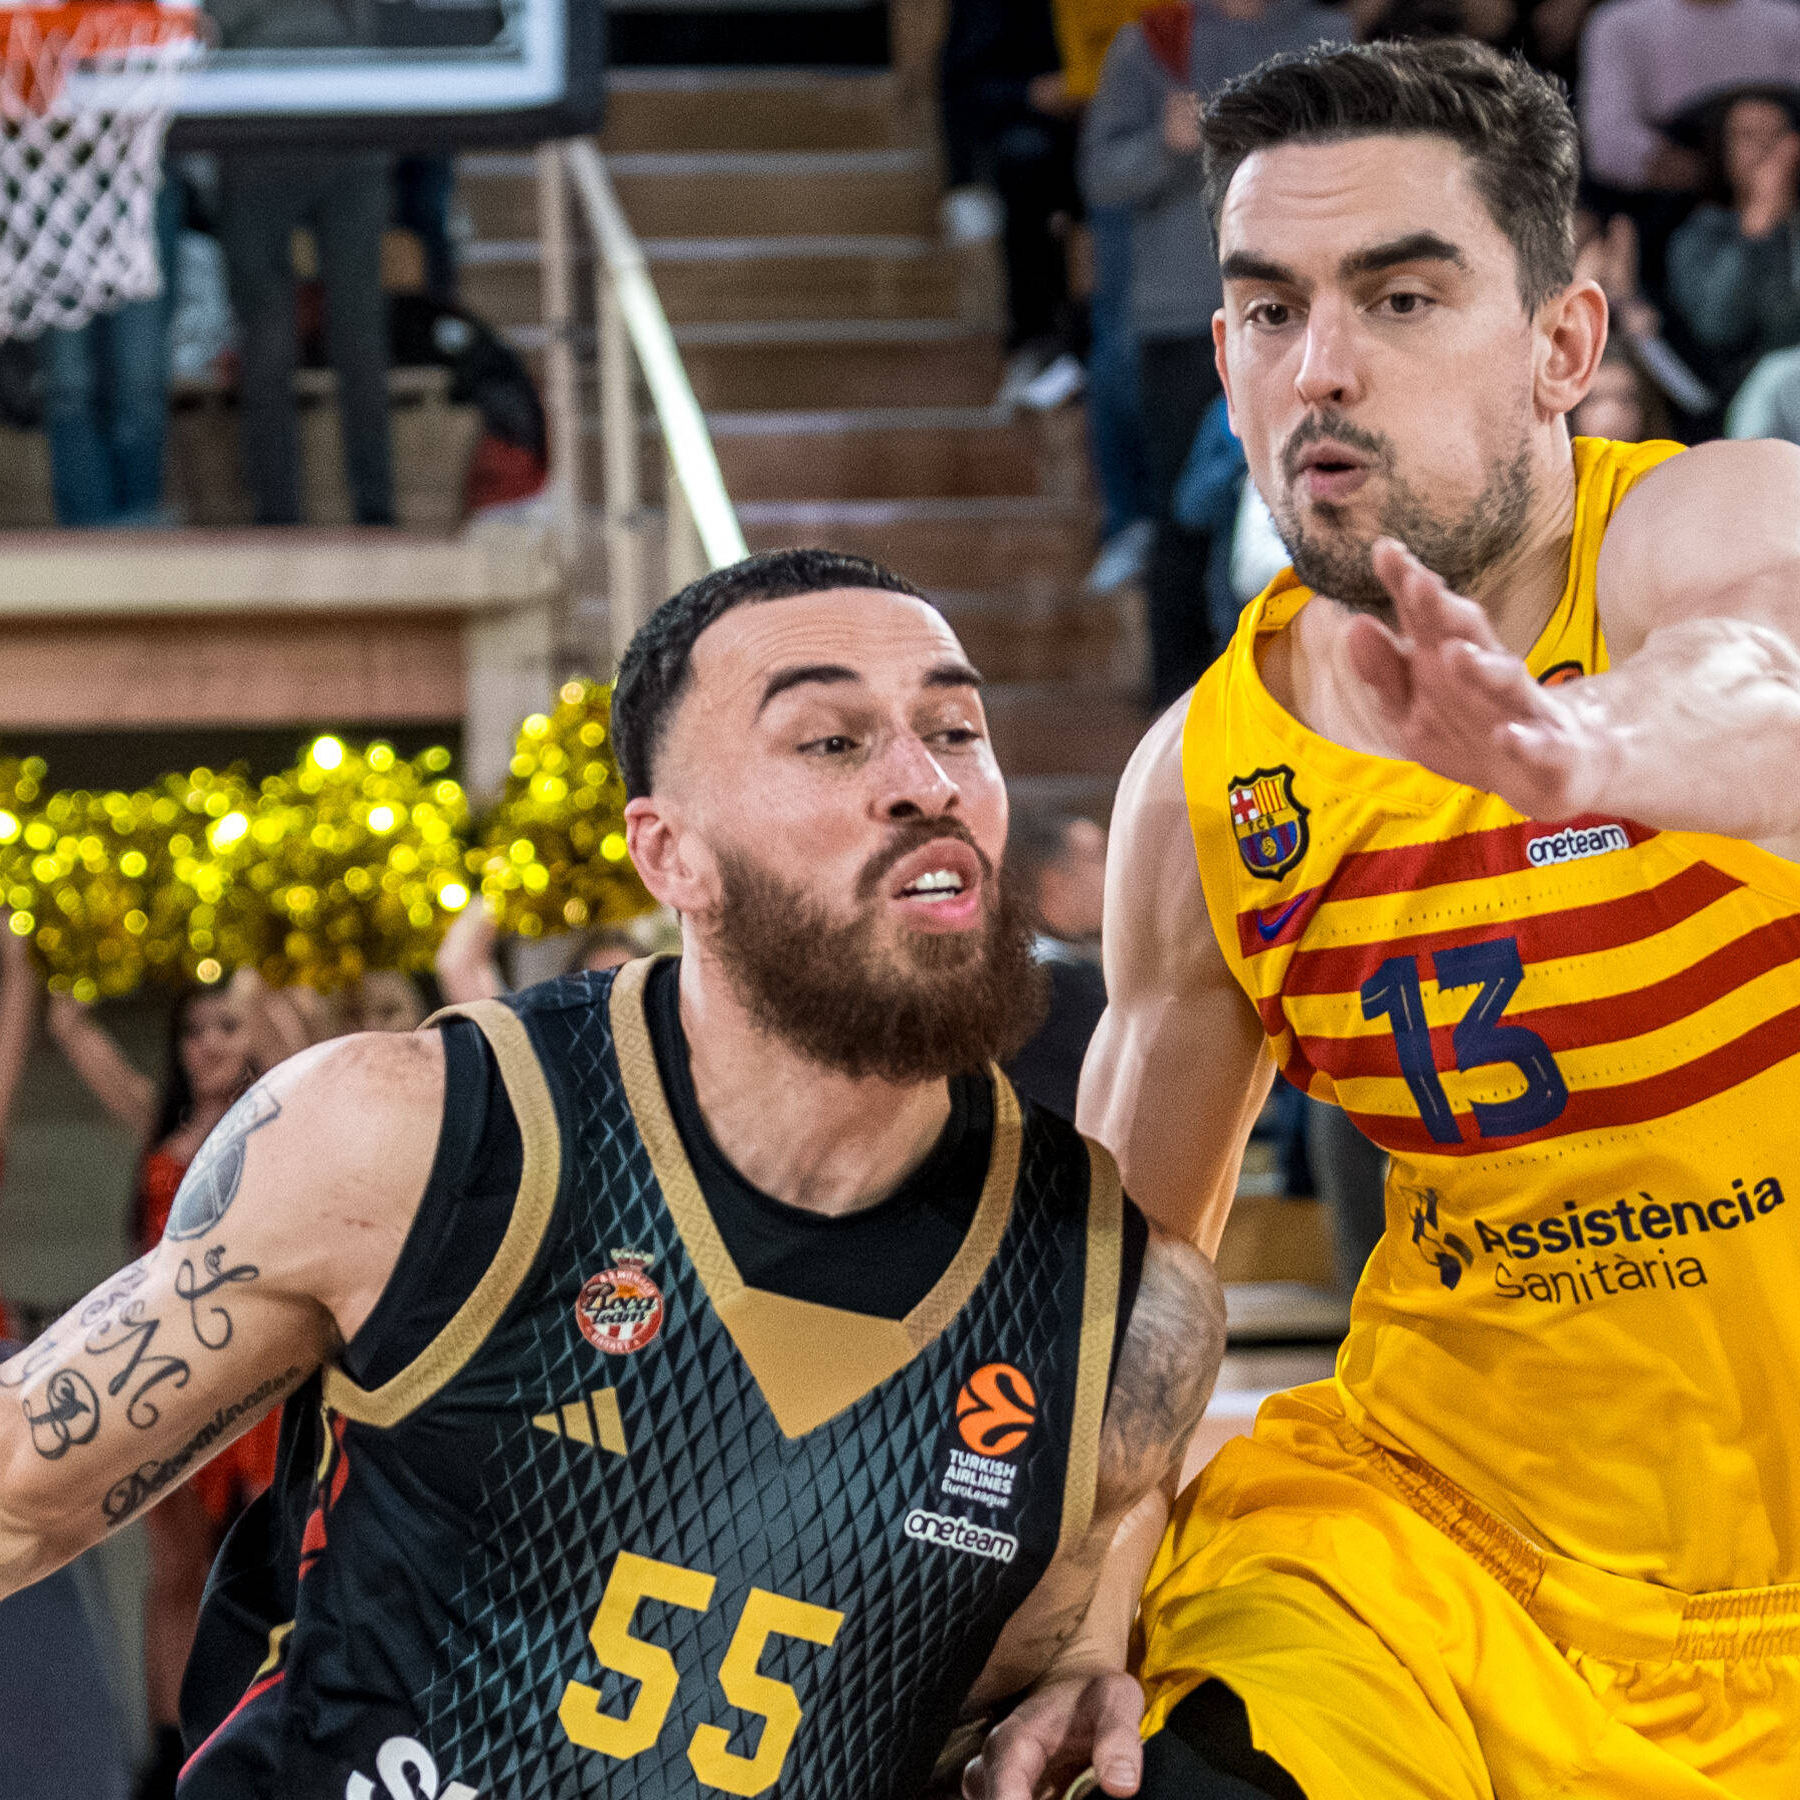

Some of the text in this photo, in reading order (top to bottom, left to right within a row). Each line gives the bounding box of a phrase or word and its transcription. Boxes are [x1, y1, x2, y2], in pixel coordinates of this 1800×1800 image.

[1528, 826, 1627, 865] oneteam
[1359, 936, 1570, 1144] 13
[1474, 1175, 1785, 1260] Assistència
[1494, 1248, 1708, 1304] Sanitària
[944, 1465, 1013, 1495] AIRLINES
[949, 1448, 1017, 1480] TURKISH
[906, 1511, 1017, 1563] oneteam
[557, 1549, 846, 1799] 55
